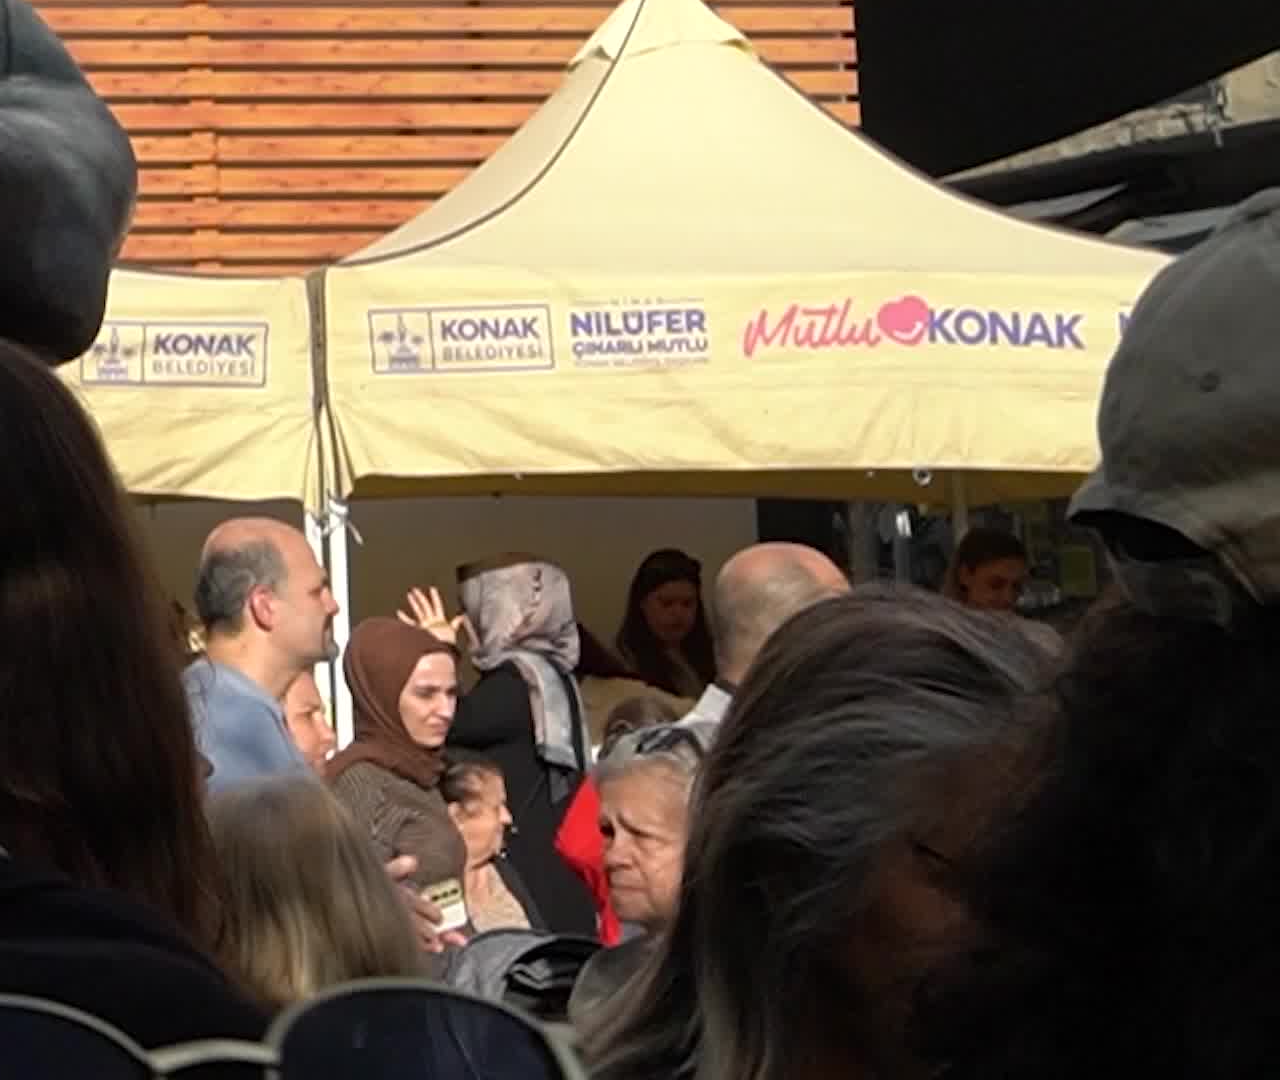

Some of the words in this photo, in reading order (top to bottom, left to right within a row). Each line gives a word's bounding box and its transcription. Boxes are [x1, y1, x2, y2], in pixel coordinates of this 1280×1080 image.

[441, 316, 540, 341] KONAK
[743, 297, 881, 358] Mutlu
[928, 308, 1086, 350] KONAK
[152, 332, 256, 357] KONAK
[646, 337, 709, 354] MUTLU
